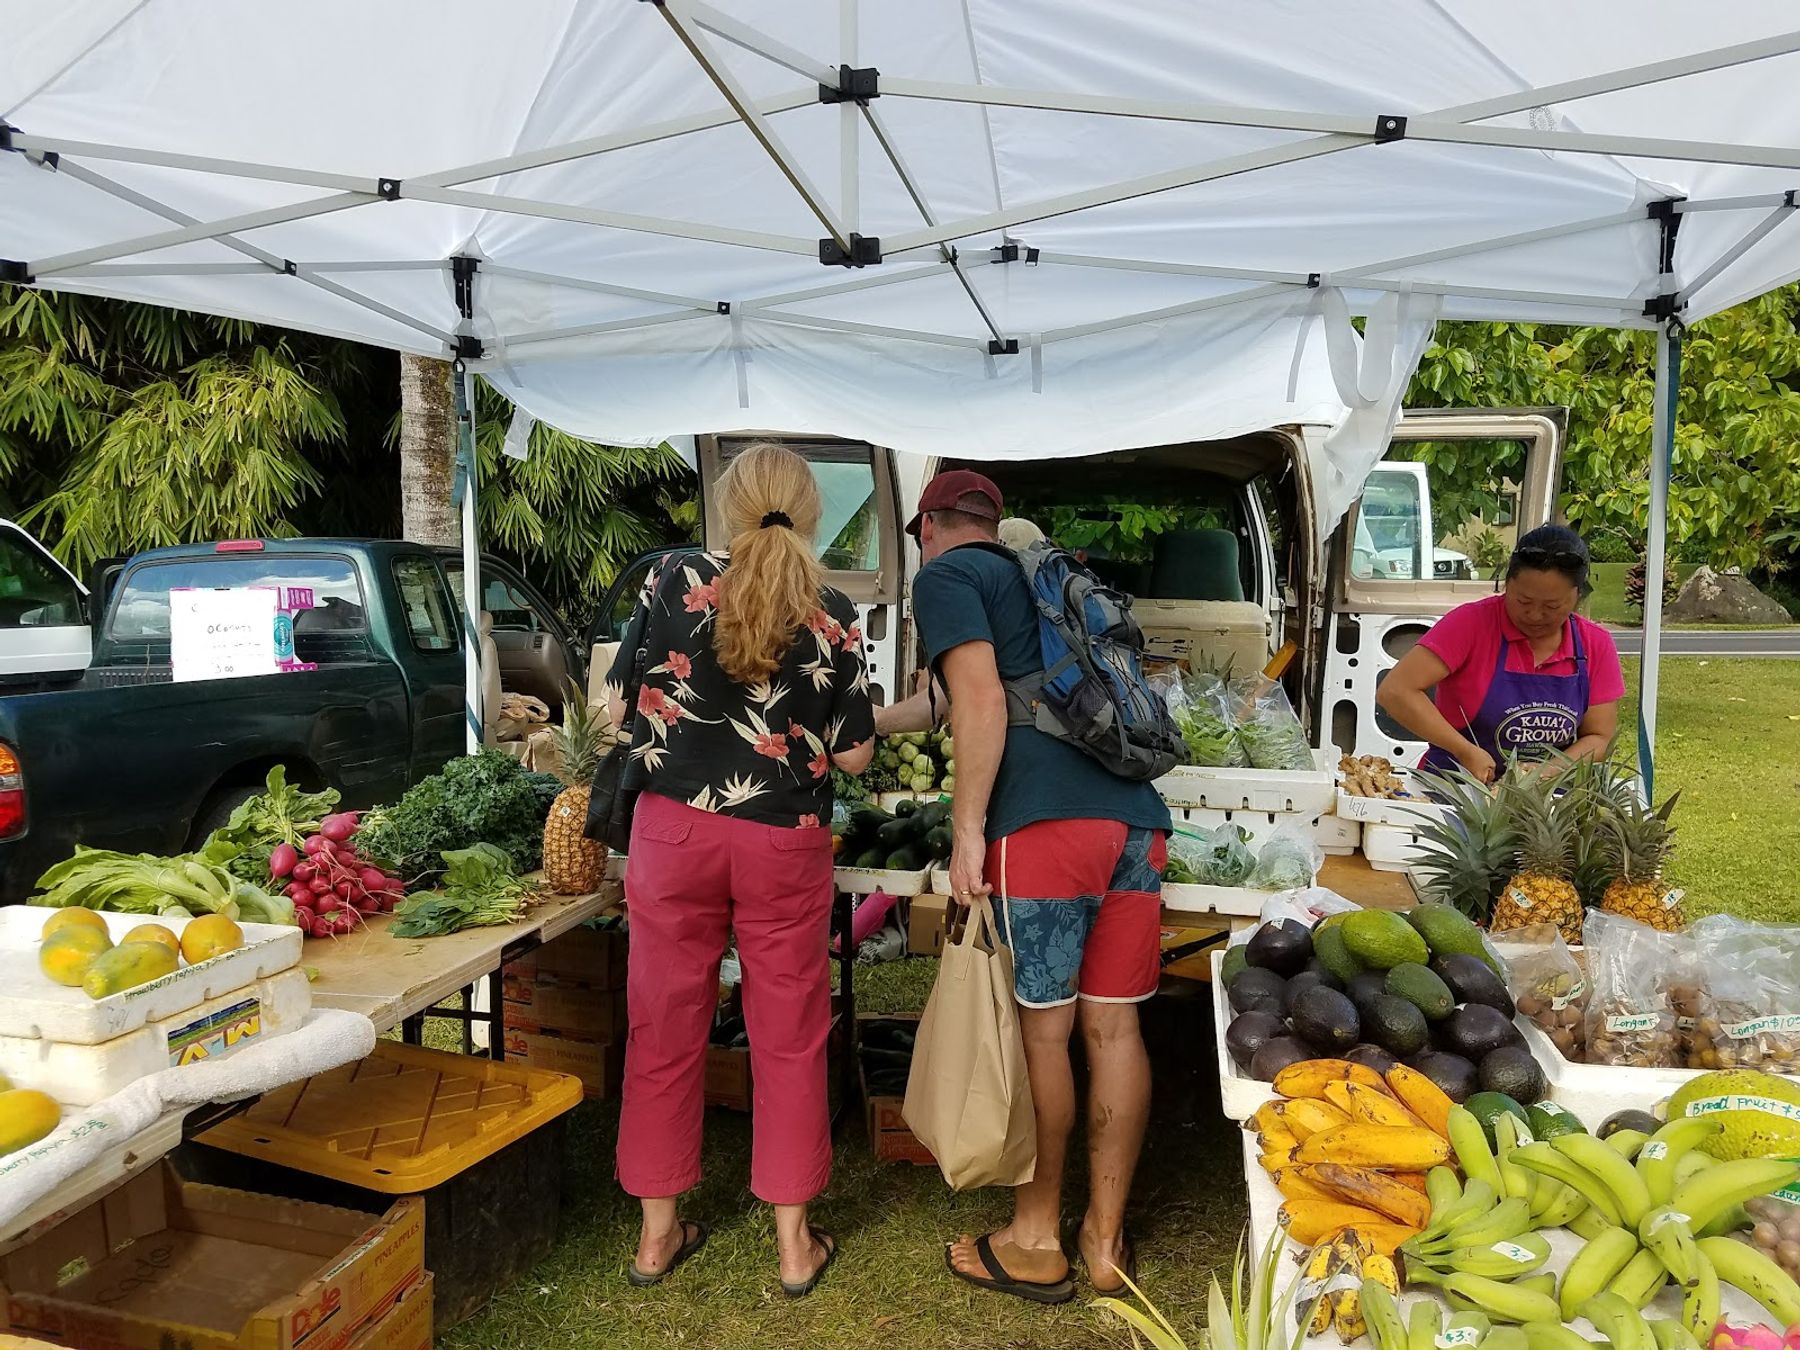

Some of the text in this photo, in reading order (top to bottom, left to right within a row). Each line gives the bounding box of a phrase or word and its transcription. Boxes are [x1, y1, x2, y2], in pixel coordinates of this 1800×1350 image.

[1505, 726, 1573, 743] GROWN
[1614, 1017, 1648, 1030] Longan
[1731, 1020, 1770, 1036] Longan
[1737, 1096, 1777, 1112] Fruit
